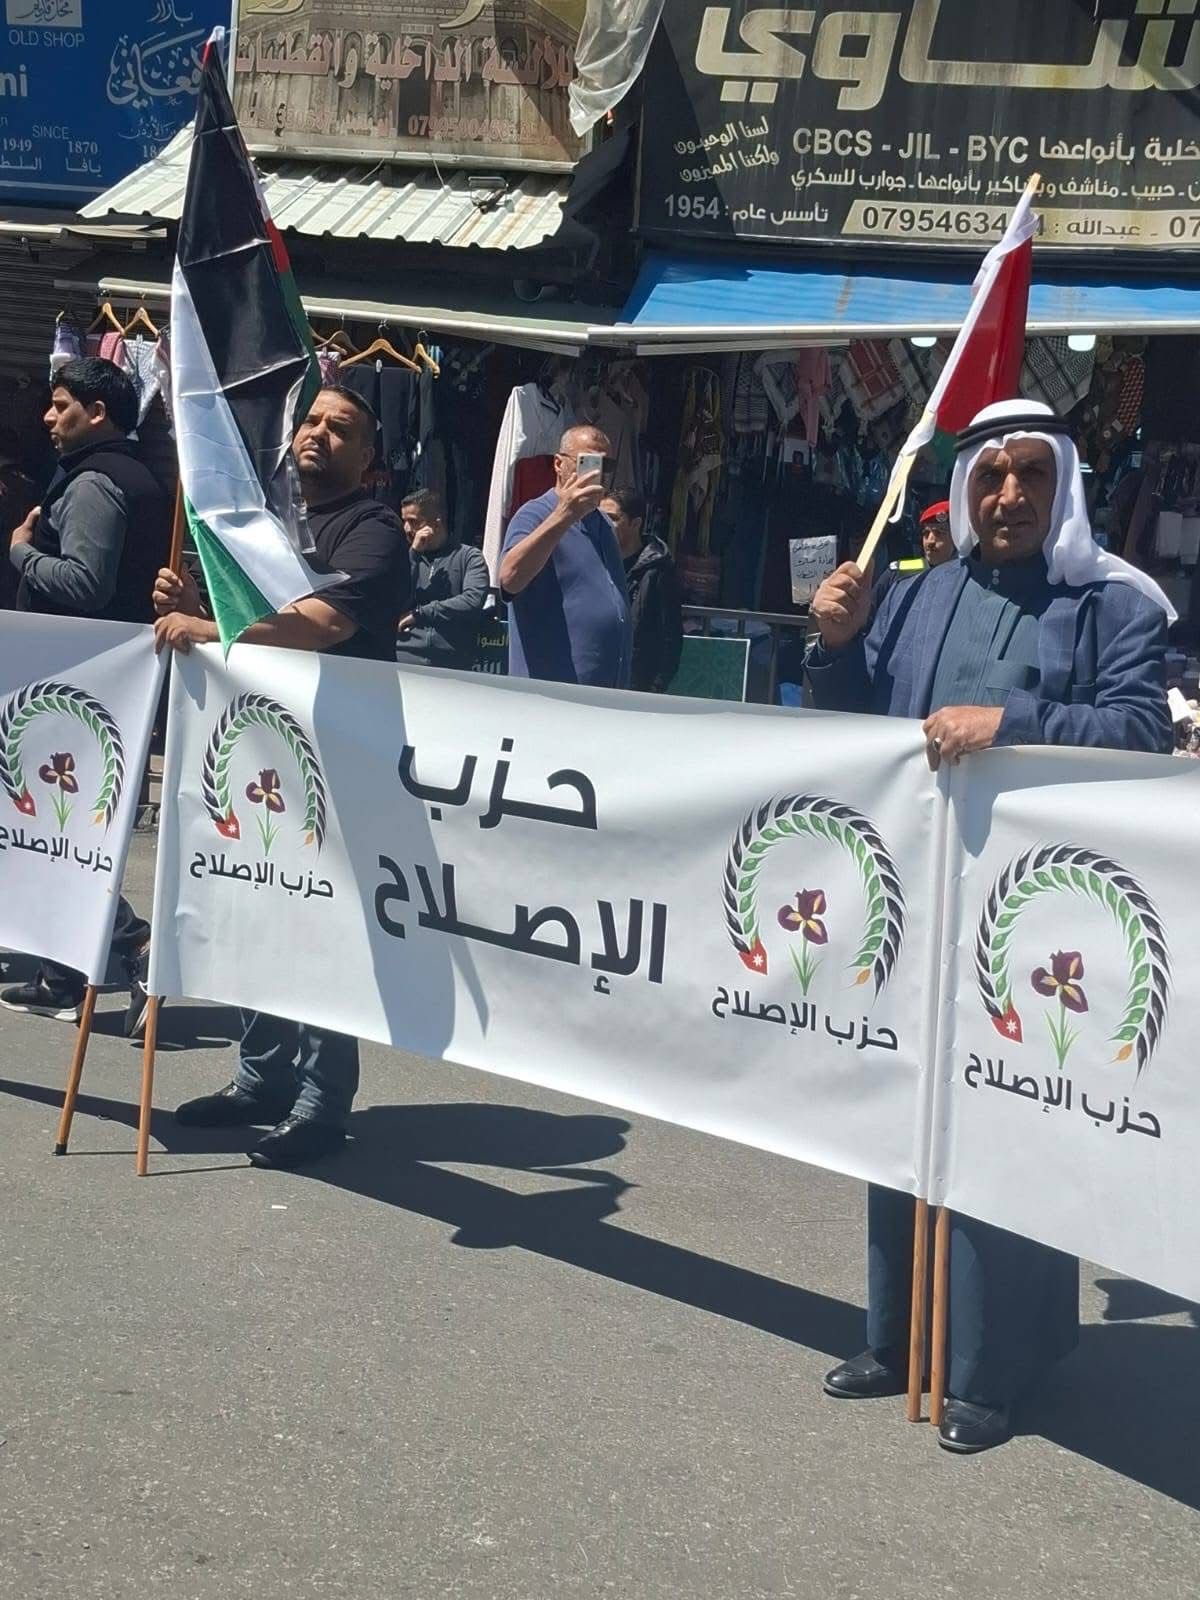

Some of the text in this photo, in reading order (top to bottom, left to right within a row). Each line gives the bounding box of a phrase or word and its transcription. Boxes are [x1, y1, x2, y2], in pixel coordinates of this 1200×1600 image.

[8, 29, 86, 48] OLD SHOP
[365, 36, 471, 91] الداخلية
[32, 124, 70, 140] SINCE
[741, 114, 770, 138] لسنا
[2, 137, 33, 152] 1949
[67, 140, 99, 155] 1870
[791, 127, 873, 157] CBCS
[897, 132, 941, 160] JIL
[967, 135, 1030, 164] BYC
[1039, 132, 1136, 166] بأنواعها
[65, 157, 103, 178] يافا
[741, 142, 780, 169] ولكننا
[790, 168, 855, 192] للسكري
[859, 171, 906, 193] جوارب
[917, 169, 981, 195] بأنواعها
[1059, 175, 1119, 198] مناشف
[1130, 183, 1176, 202] حبيب
[664, 194, 721, 220] 1954
[732, 203, 767, 223] عام
[769, 201, 829, 225] تأسس
[1065, 215, 1142, 239] عبدالله
[398, 737, 598, 831] حزب
[74, 846, 114, 873] حزب
[189, 851, 334, 899] حزب الإصلاح
[374, 853, 669, 995] الإصلاح
[711, 985, 899, 1051] حزب الإصلاح
[964, 1052, 1162, 1139] حزب الإصلاح
